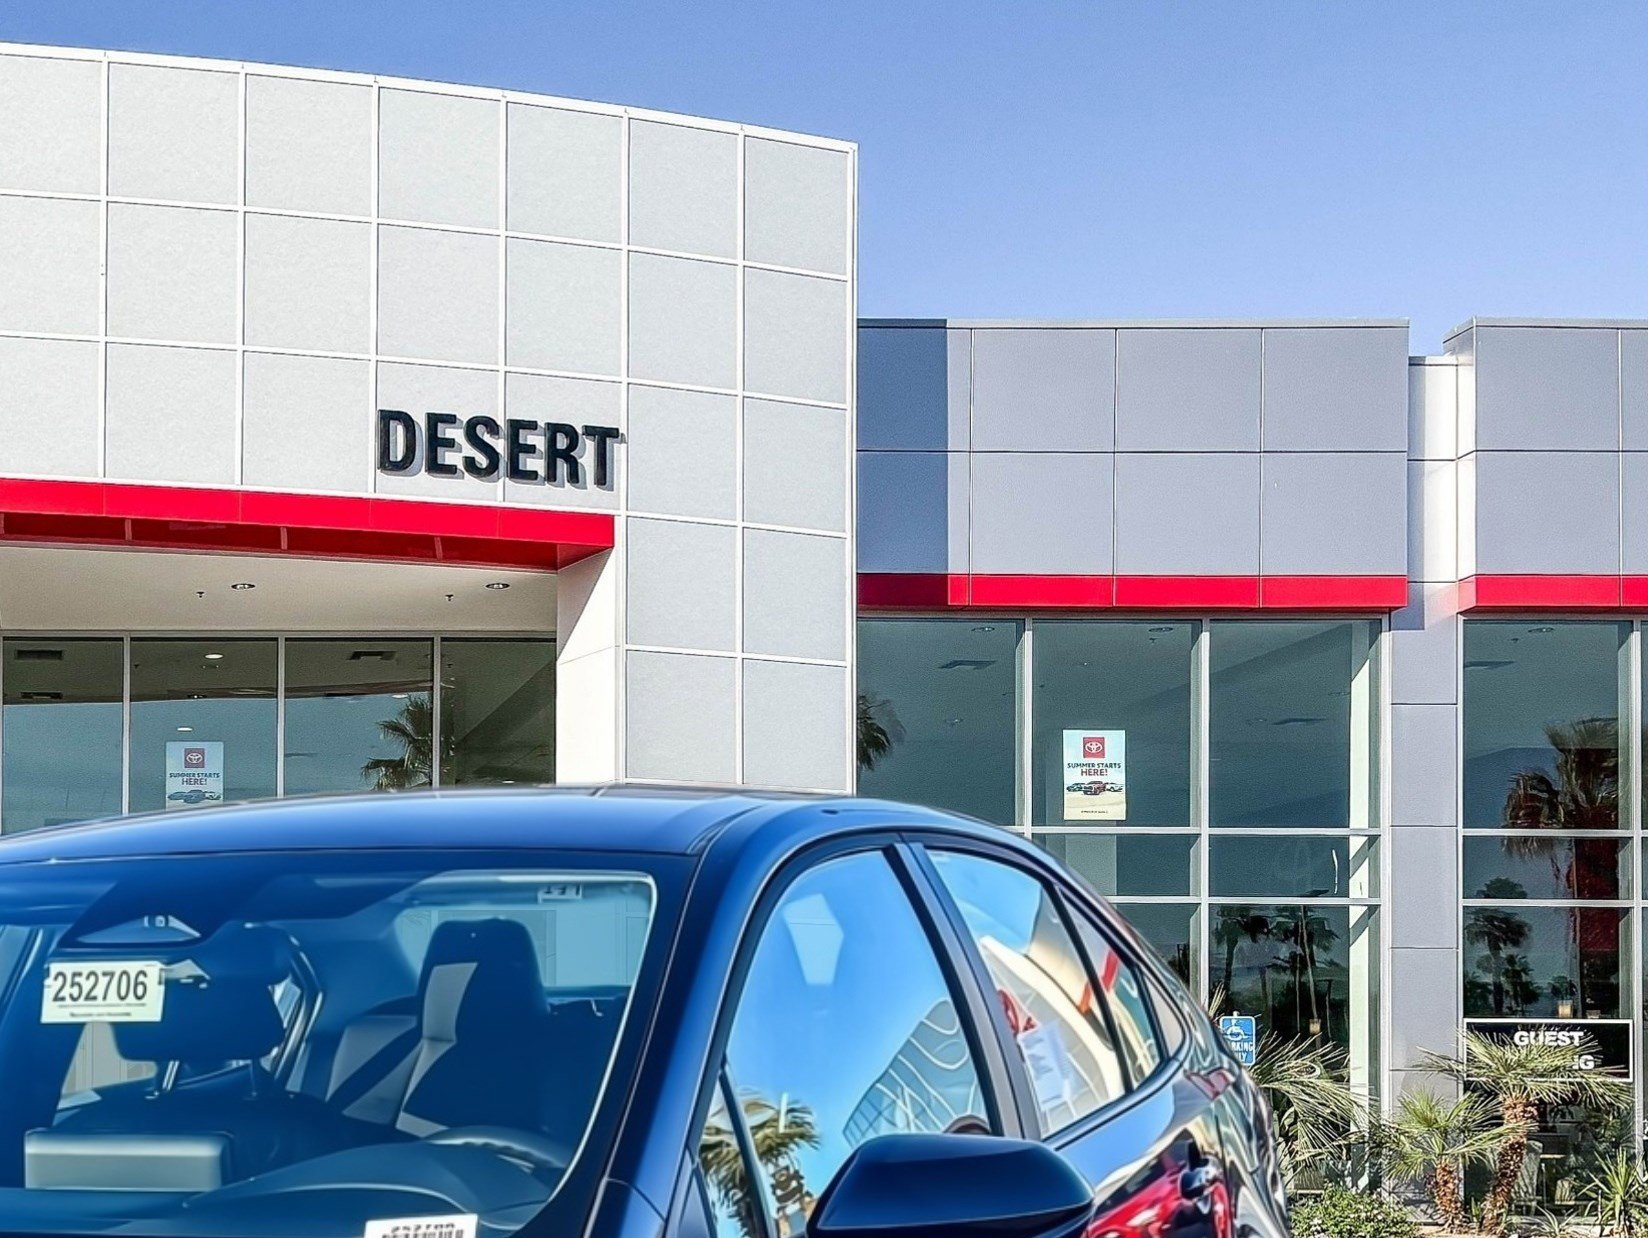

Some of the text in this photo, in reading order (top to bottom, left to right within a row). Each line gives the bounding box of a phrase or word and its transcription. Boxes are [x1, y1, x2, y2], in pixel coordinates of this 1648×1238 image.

[377, 409, 620, 486] DESERT
[1080, 768, 1108, 776] HERE!
[181, 778, 208, 786] HERE!
[52, 970, 148, 1002] 252706
[1513, 1031, 1584, 1047] GUEST
